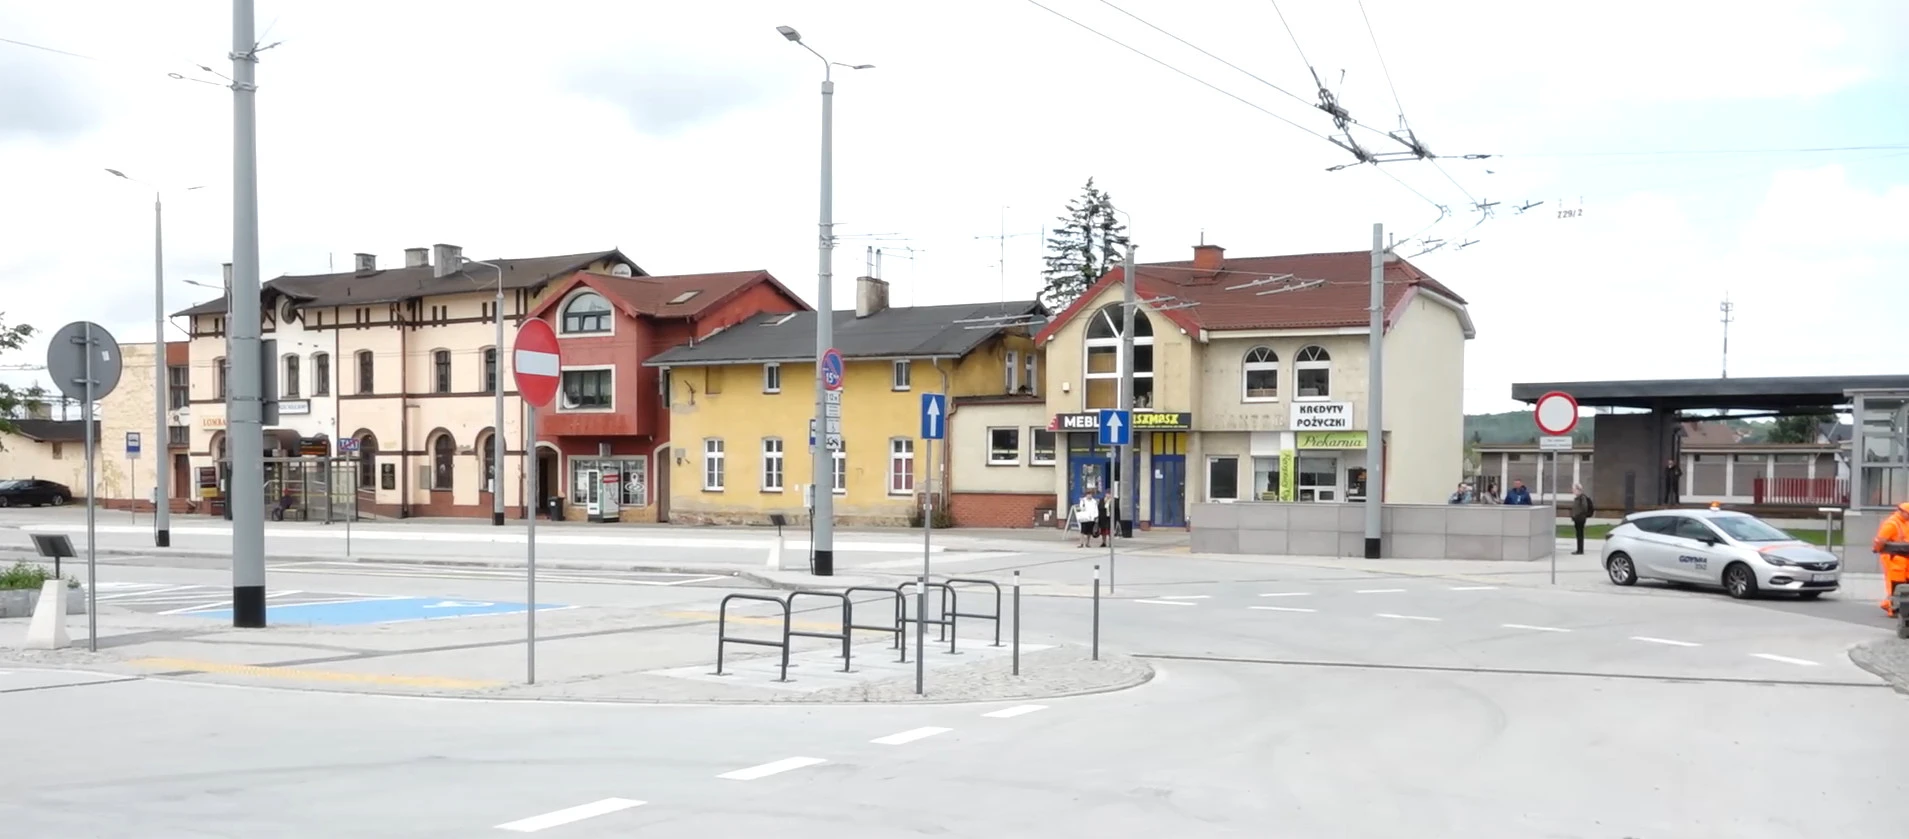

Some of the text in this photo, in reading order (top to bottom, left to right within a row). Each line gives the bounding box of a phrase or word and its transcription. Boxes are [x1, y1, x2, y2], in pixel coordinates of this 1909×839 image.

[1300, 405, 1344, 414] KREDYTY
[203, 417, 226, 427] LOMBA
[1064, 416, 1099, 427] MEBL
[1296, 415, 1346, 427] POŻYCZKI
[340, 439, 359, 450] TAXI
[1303, 432, 1362, 447] Piekarnia
